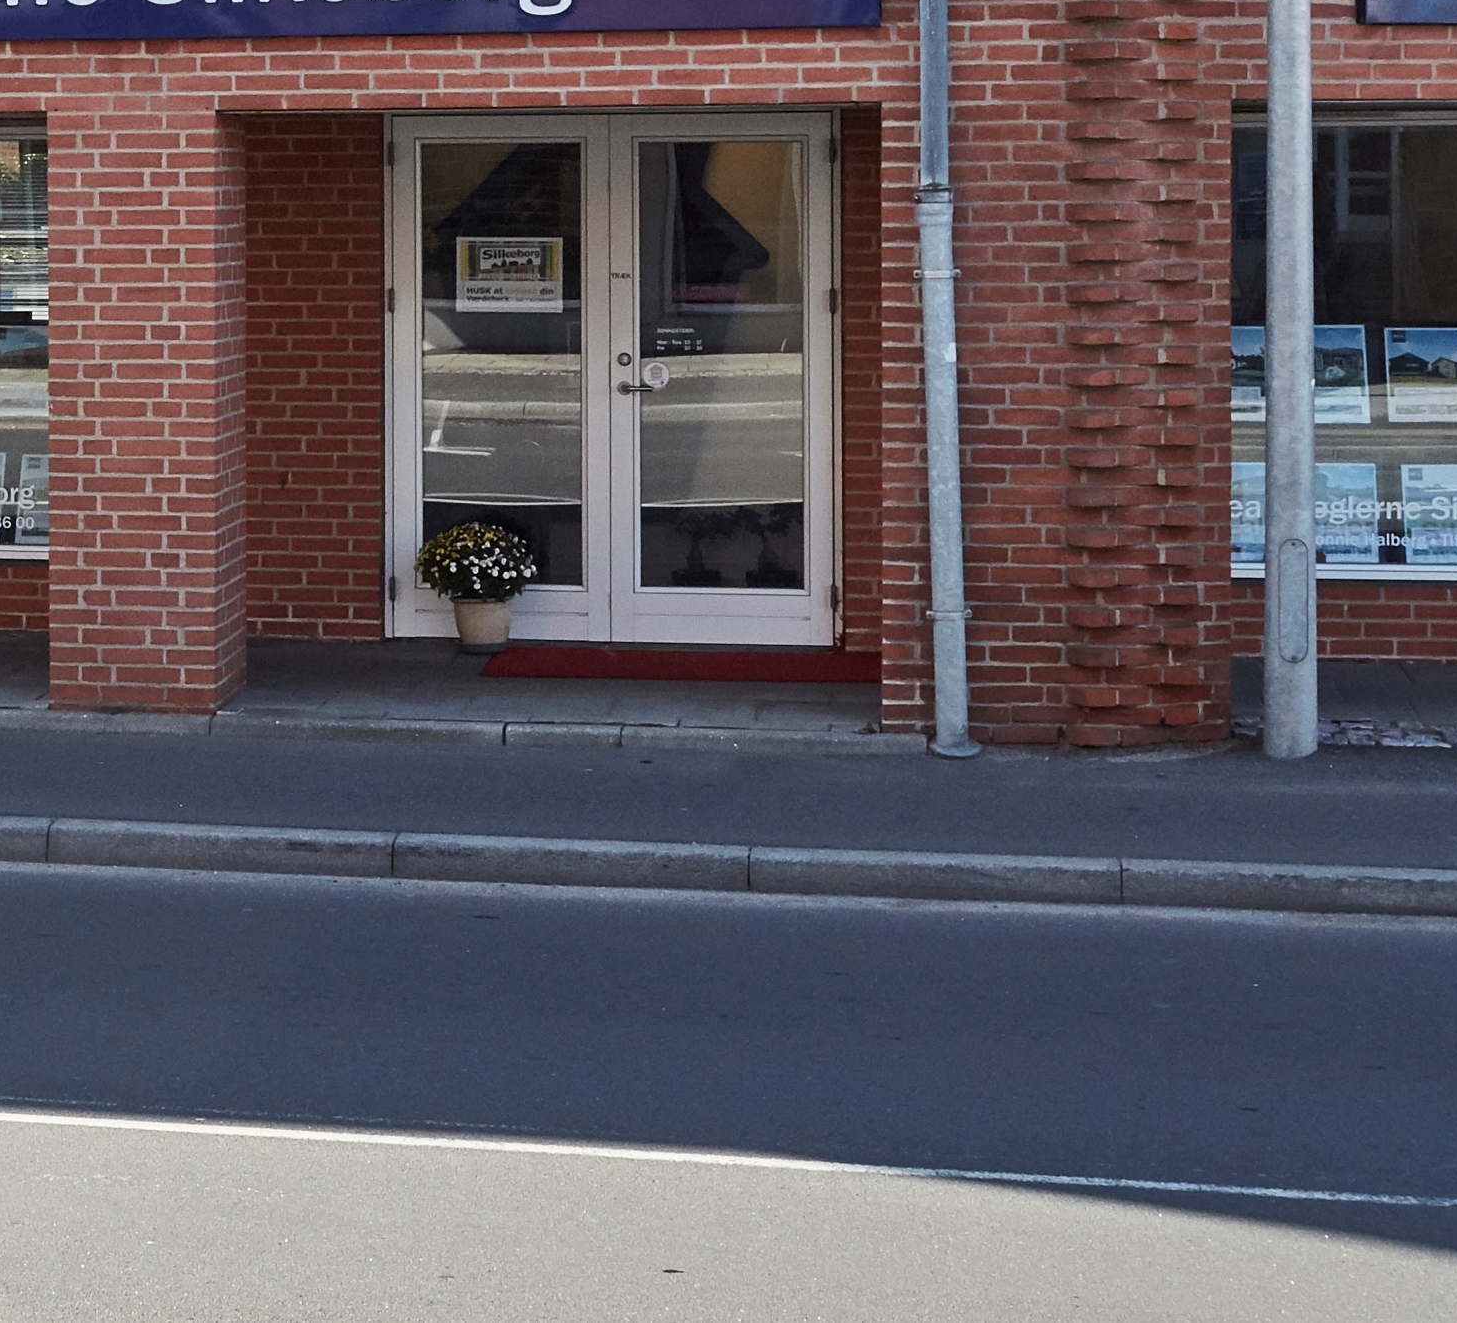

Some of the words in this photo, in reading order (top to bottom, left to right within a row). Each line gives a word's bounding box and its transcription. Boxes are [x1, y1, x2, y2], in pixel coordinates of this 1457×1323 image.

[481, 248, 540, 260] Silkeborg
[16, 517, 35, 529] 00
[1315, 534, 1359, 546] onnie
